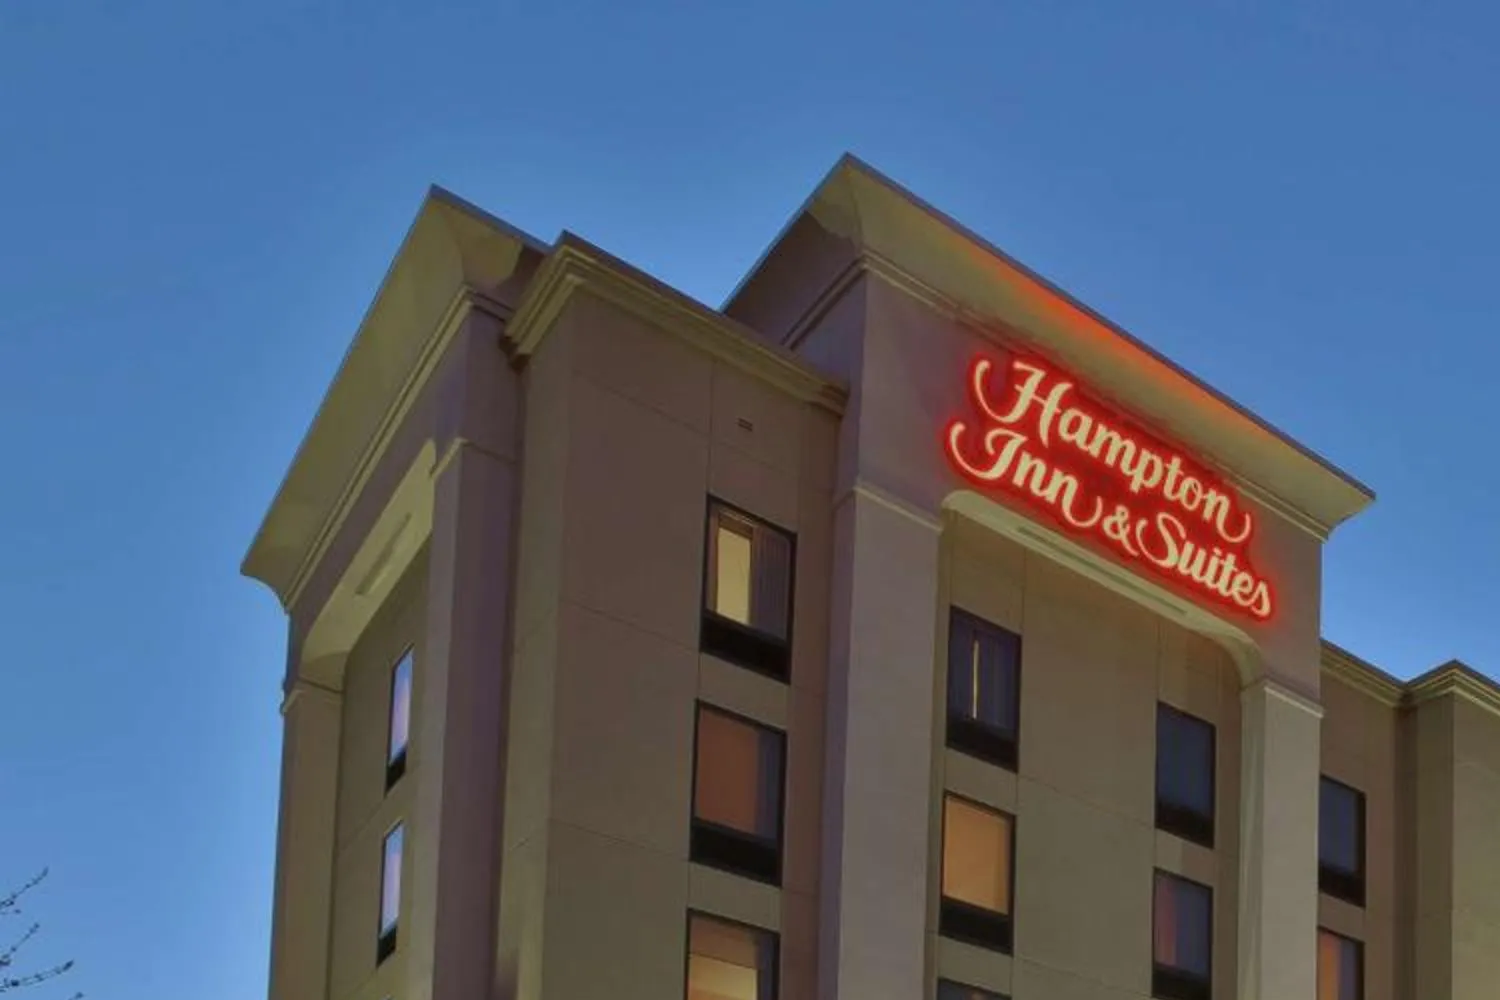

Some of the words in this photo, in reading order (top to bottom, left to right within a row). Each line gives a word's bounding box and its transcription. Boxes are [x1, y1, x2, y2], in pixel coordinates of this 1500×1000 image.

[950, 421, 1103, 528] Inn
[1102, 505, 1139, 557] &
[1135, 512, 1272, 617] Suites
[974, 359, 1252, 543] Hampton
